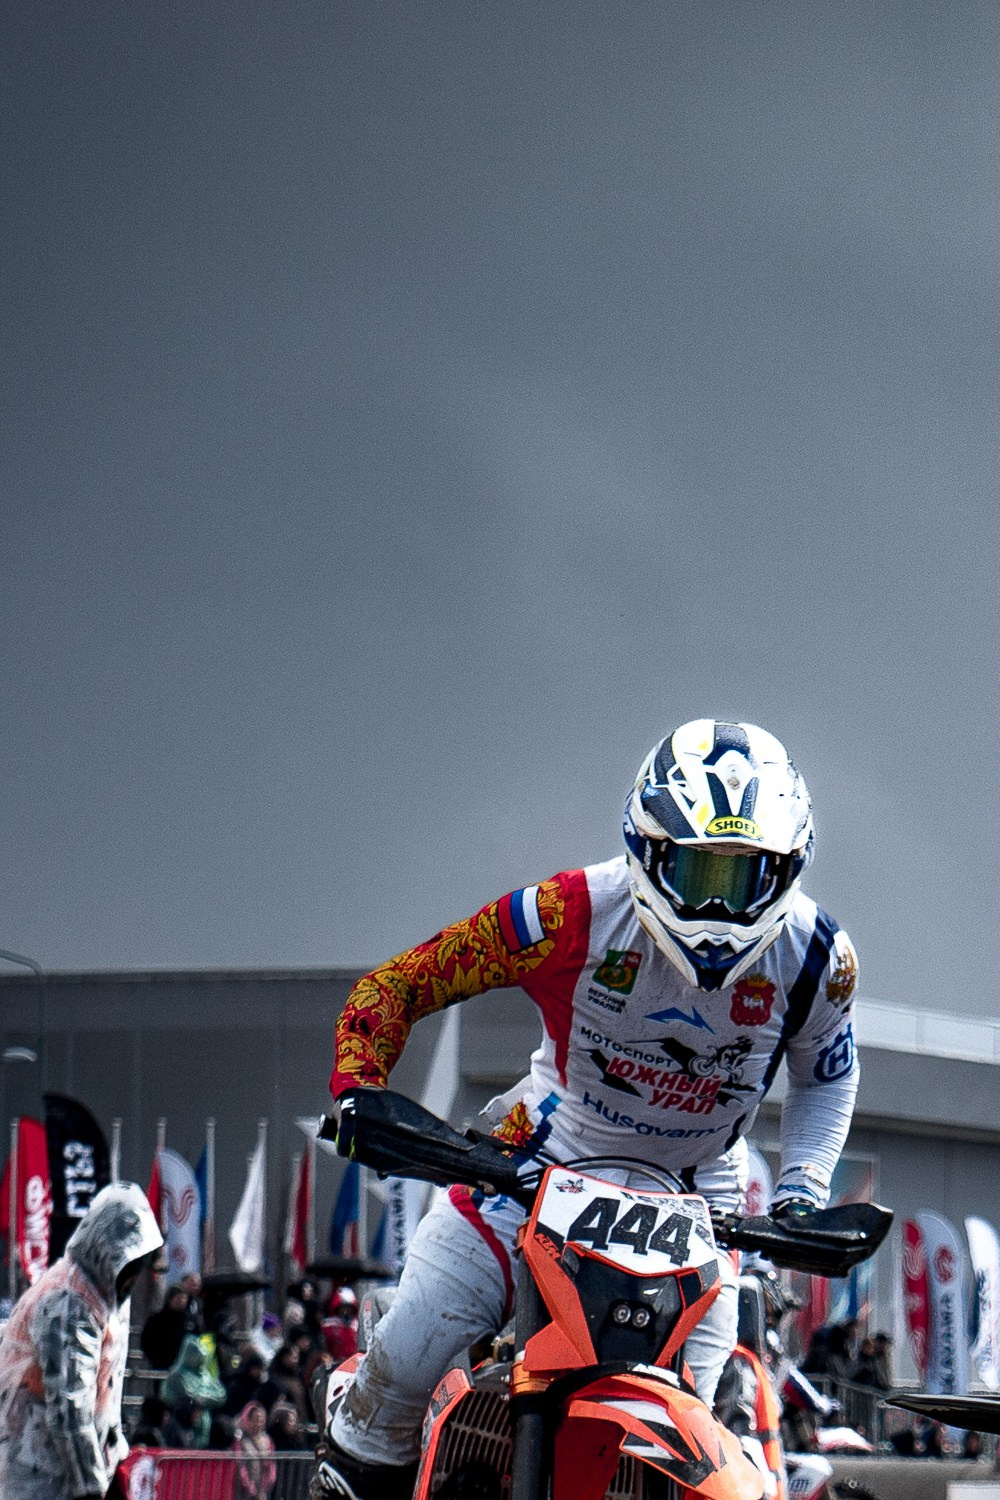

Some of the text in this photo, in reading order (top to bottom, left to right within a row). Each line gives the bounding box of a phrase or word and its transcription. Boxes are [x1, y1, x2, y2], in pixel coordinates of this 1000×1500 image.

[714, 820, 755, 834] SHOEI
[581, 1026, 674, 1068] МОТОСПОРТ
[606, 1056, 722, 1097] ЮЖНЫЙ
[648, 1089, 718, 1116] УРАЛ
[566, 1196, 694, 1267] 444
